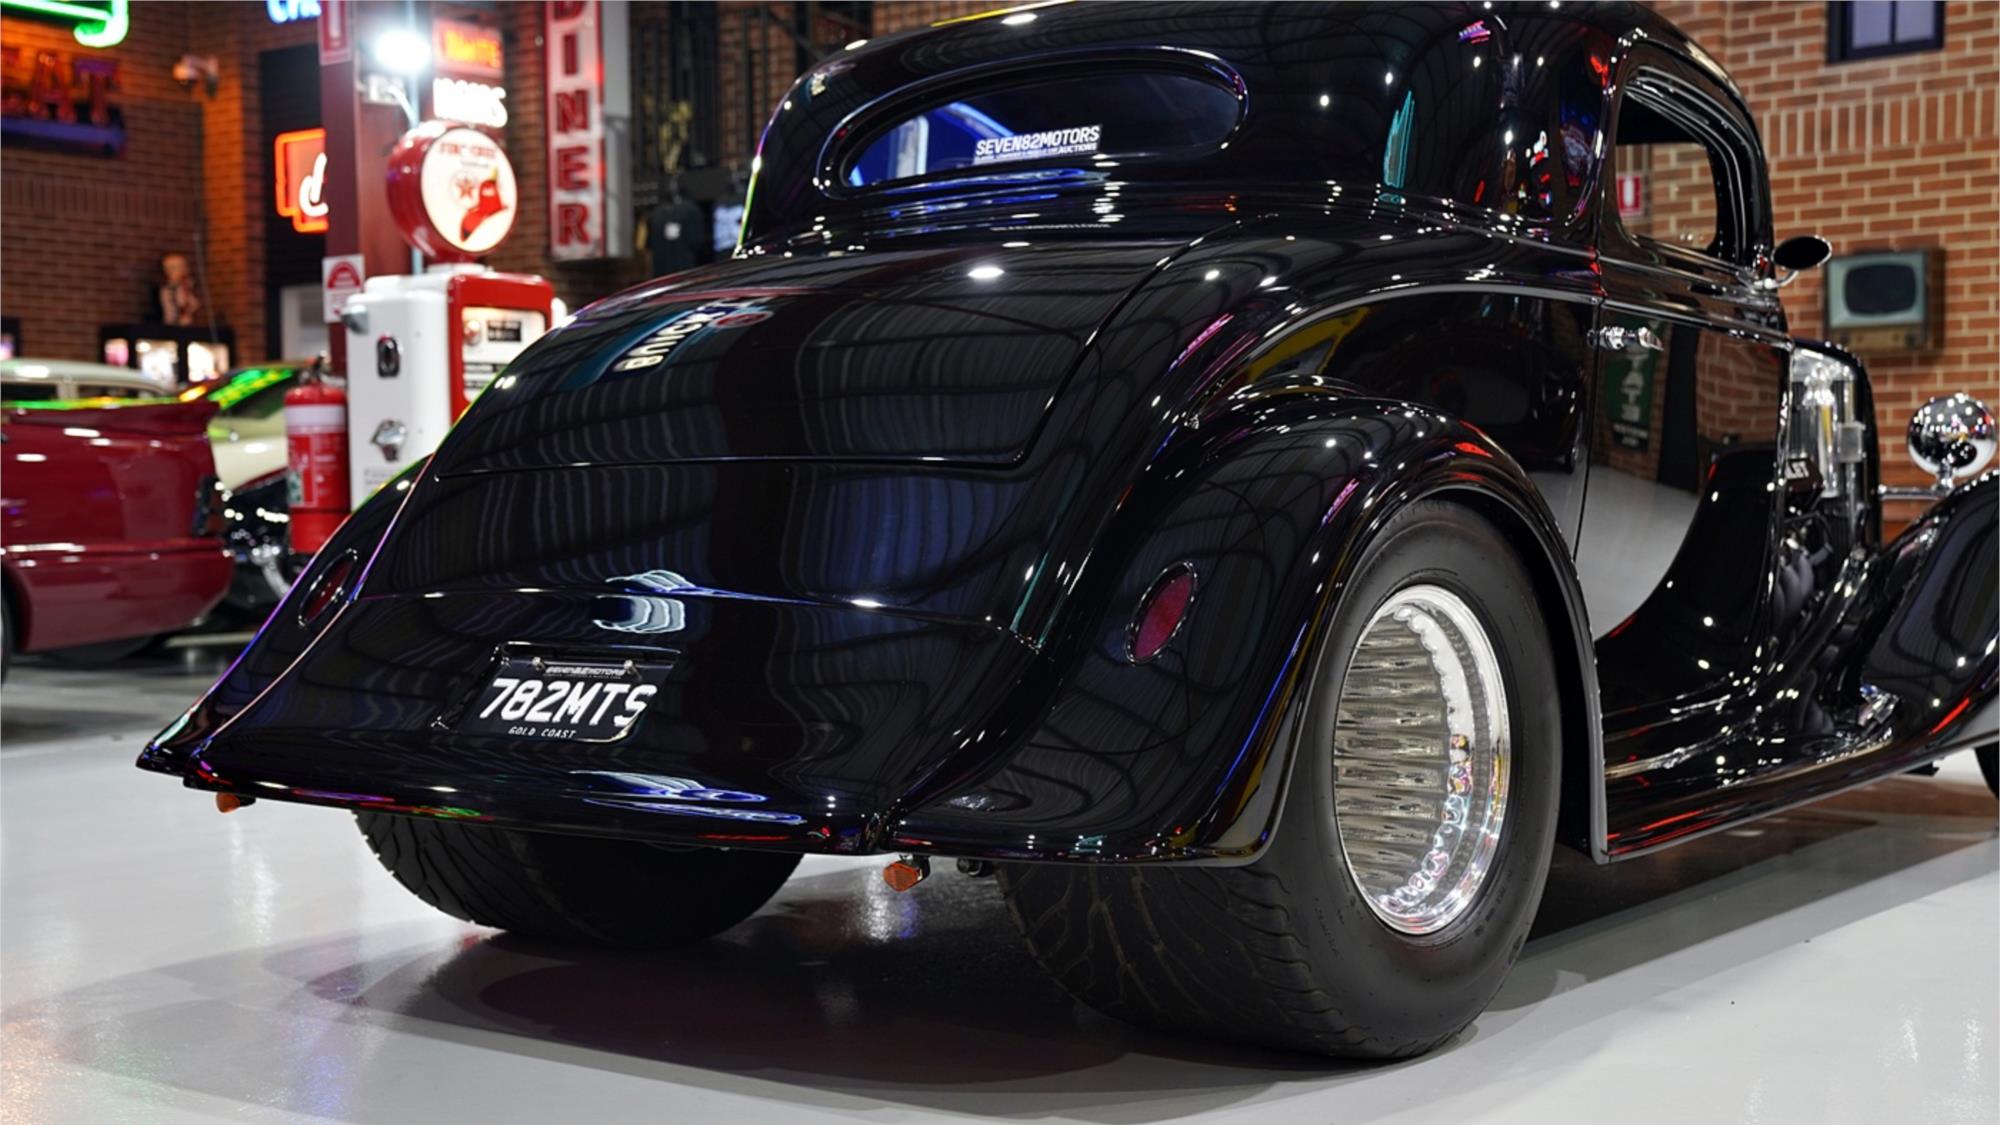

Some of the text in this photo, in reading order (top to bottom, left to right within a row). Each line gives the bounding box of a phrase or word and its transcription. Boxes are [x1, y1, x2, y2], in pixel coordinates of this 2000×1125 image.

[975, 125, 1101, 156] SEVEN82MOTORS
[480, 678, 657, 727] 782MTS
[508, 726, 576, 739] GOLD COAST
